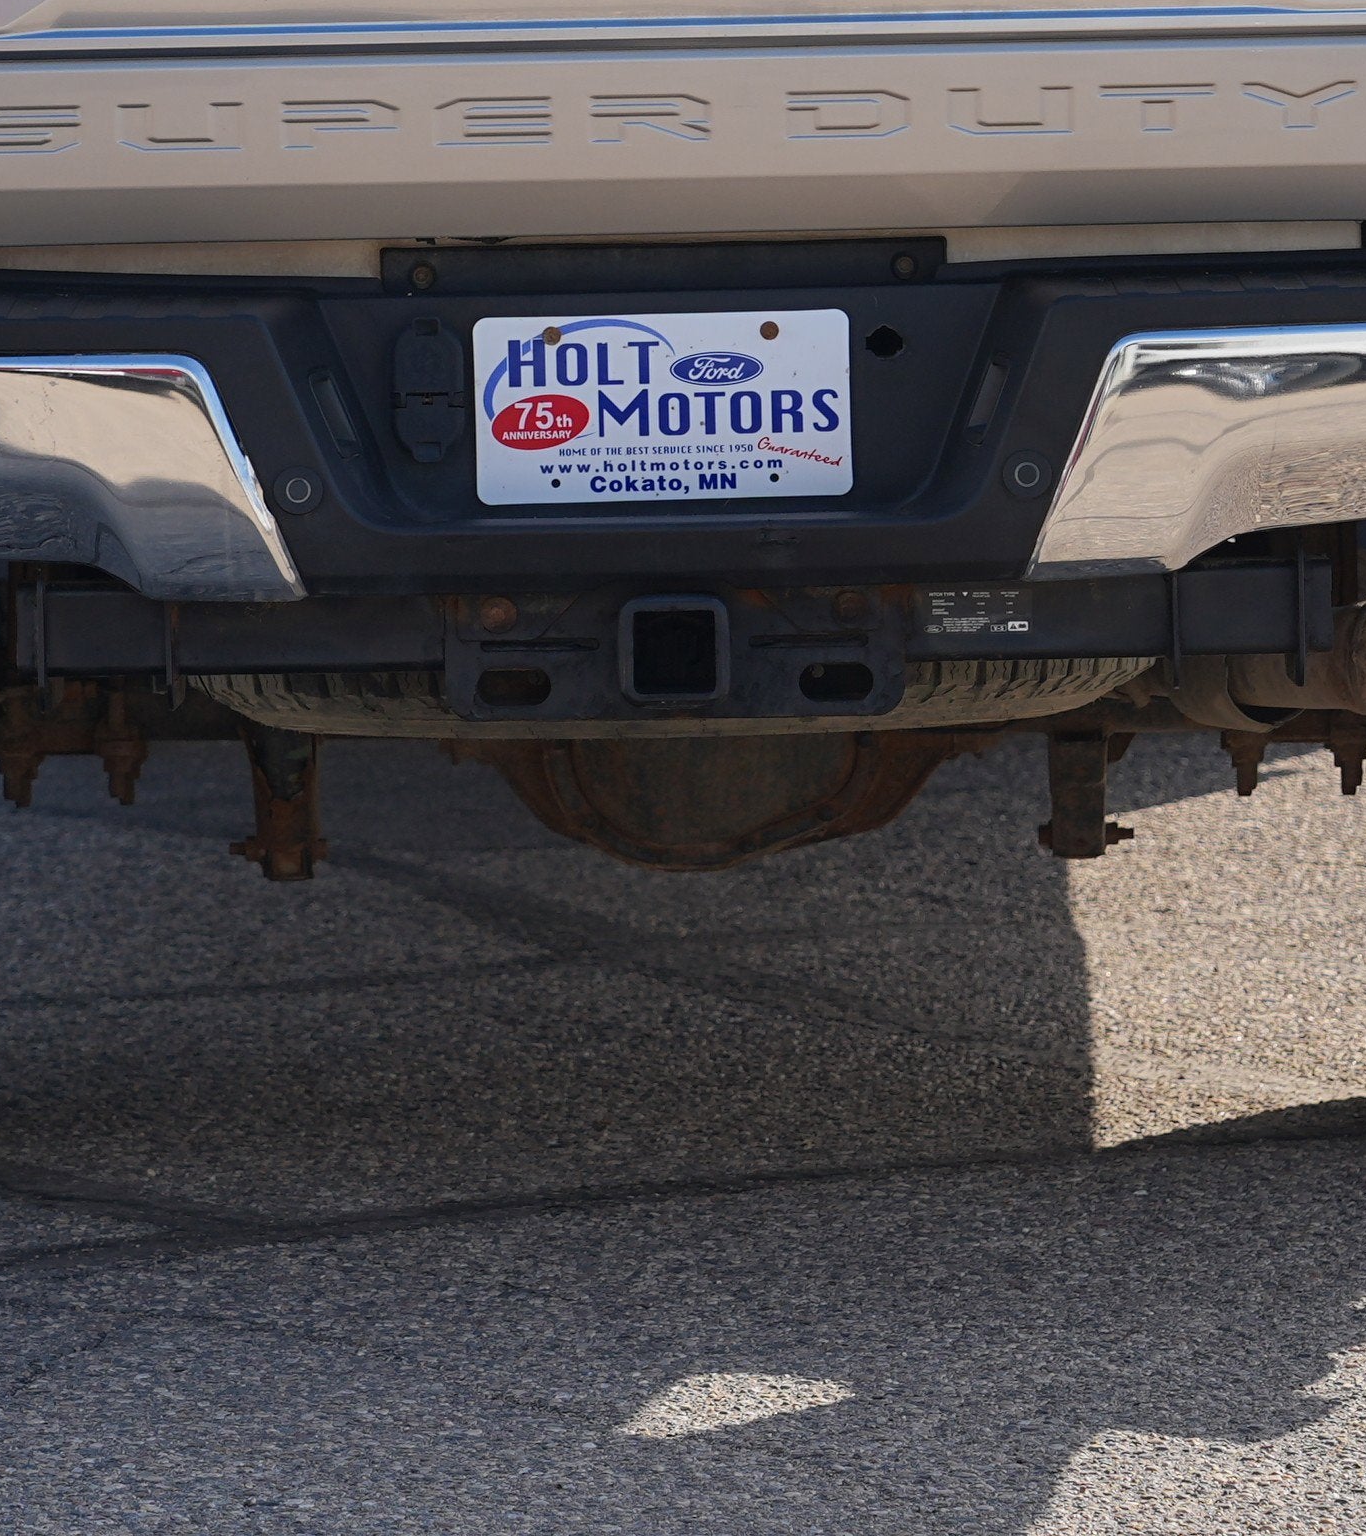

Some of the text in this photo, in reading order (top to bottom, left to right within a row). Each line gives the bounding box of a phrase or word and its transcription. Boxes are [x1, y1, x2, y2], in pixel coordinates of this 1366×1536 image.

[785, 79, 1358, 140] DUTY
[508, 339, 660, 387] HOLT
[688, 356, 745, 381] Ford
[514, 401, 573, 430] 75th
[598, 388, 840, 438] MOTORS
[502, 429, 573, 441] ANNIVERSARY
[559, 443, 754, 457] HOME OF THE BEST SERVICE SINCE 1950
[757, 436, 843, 466] Guaranteed
[540, 458, 784, 474] www.holtmotors.com
[590, 473, 737, 494] Cokato, MN
